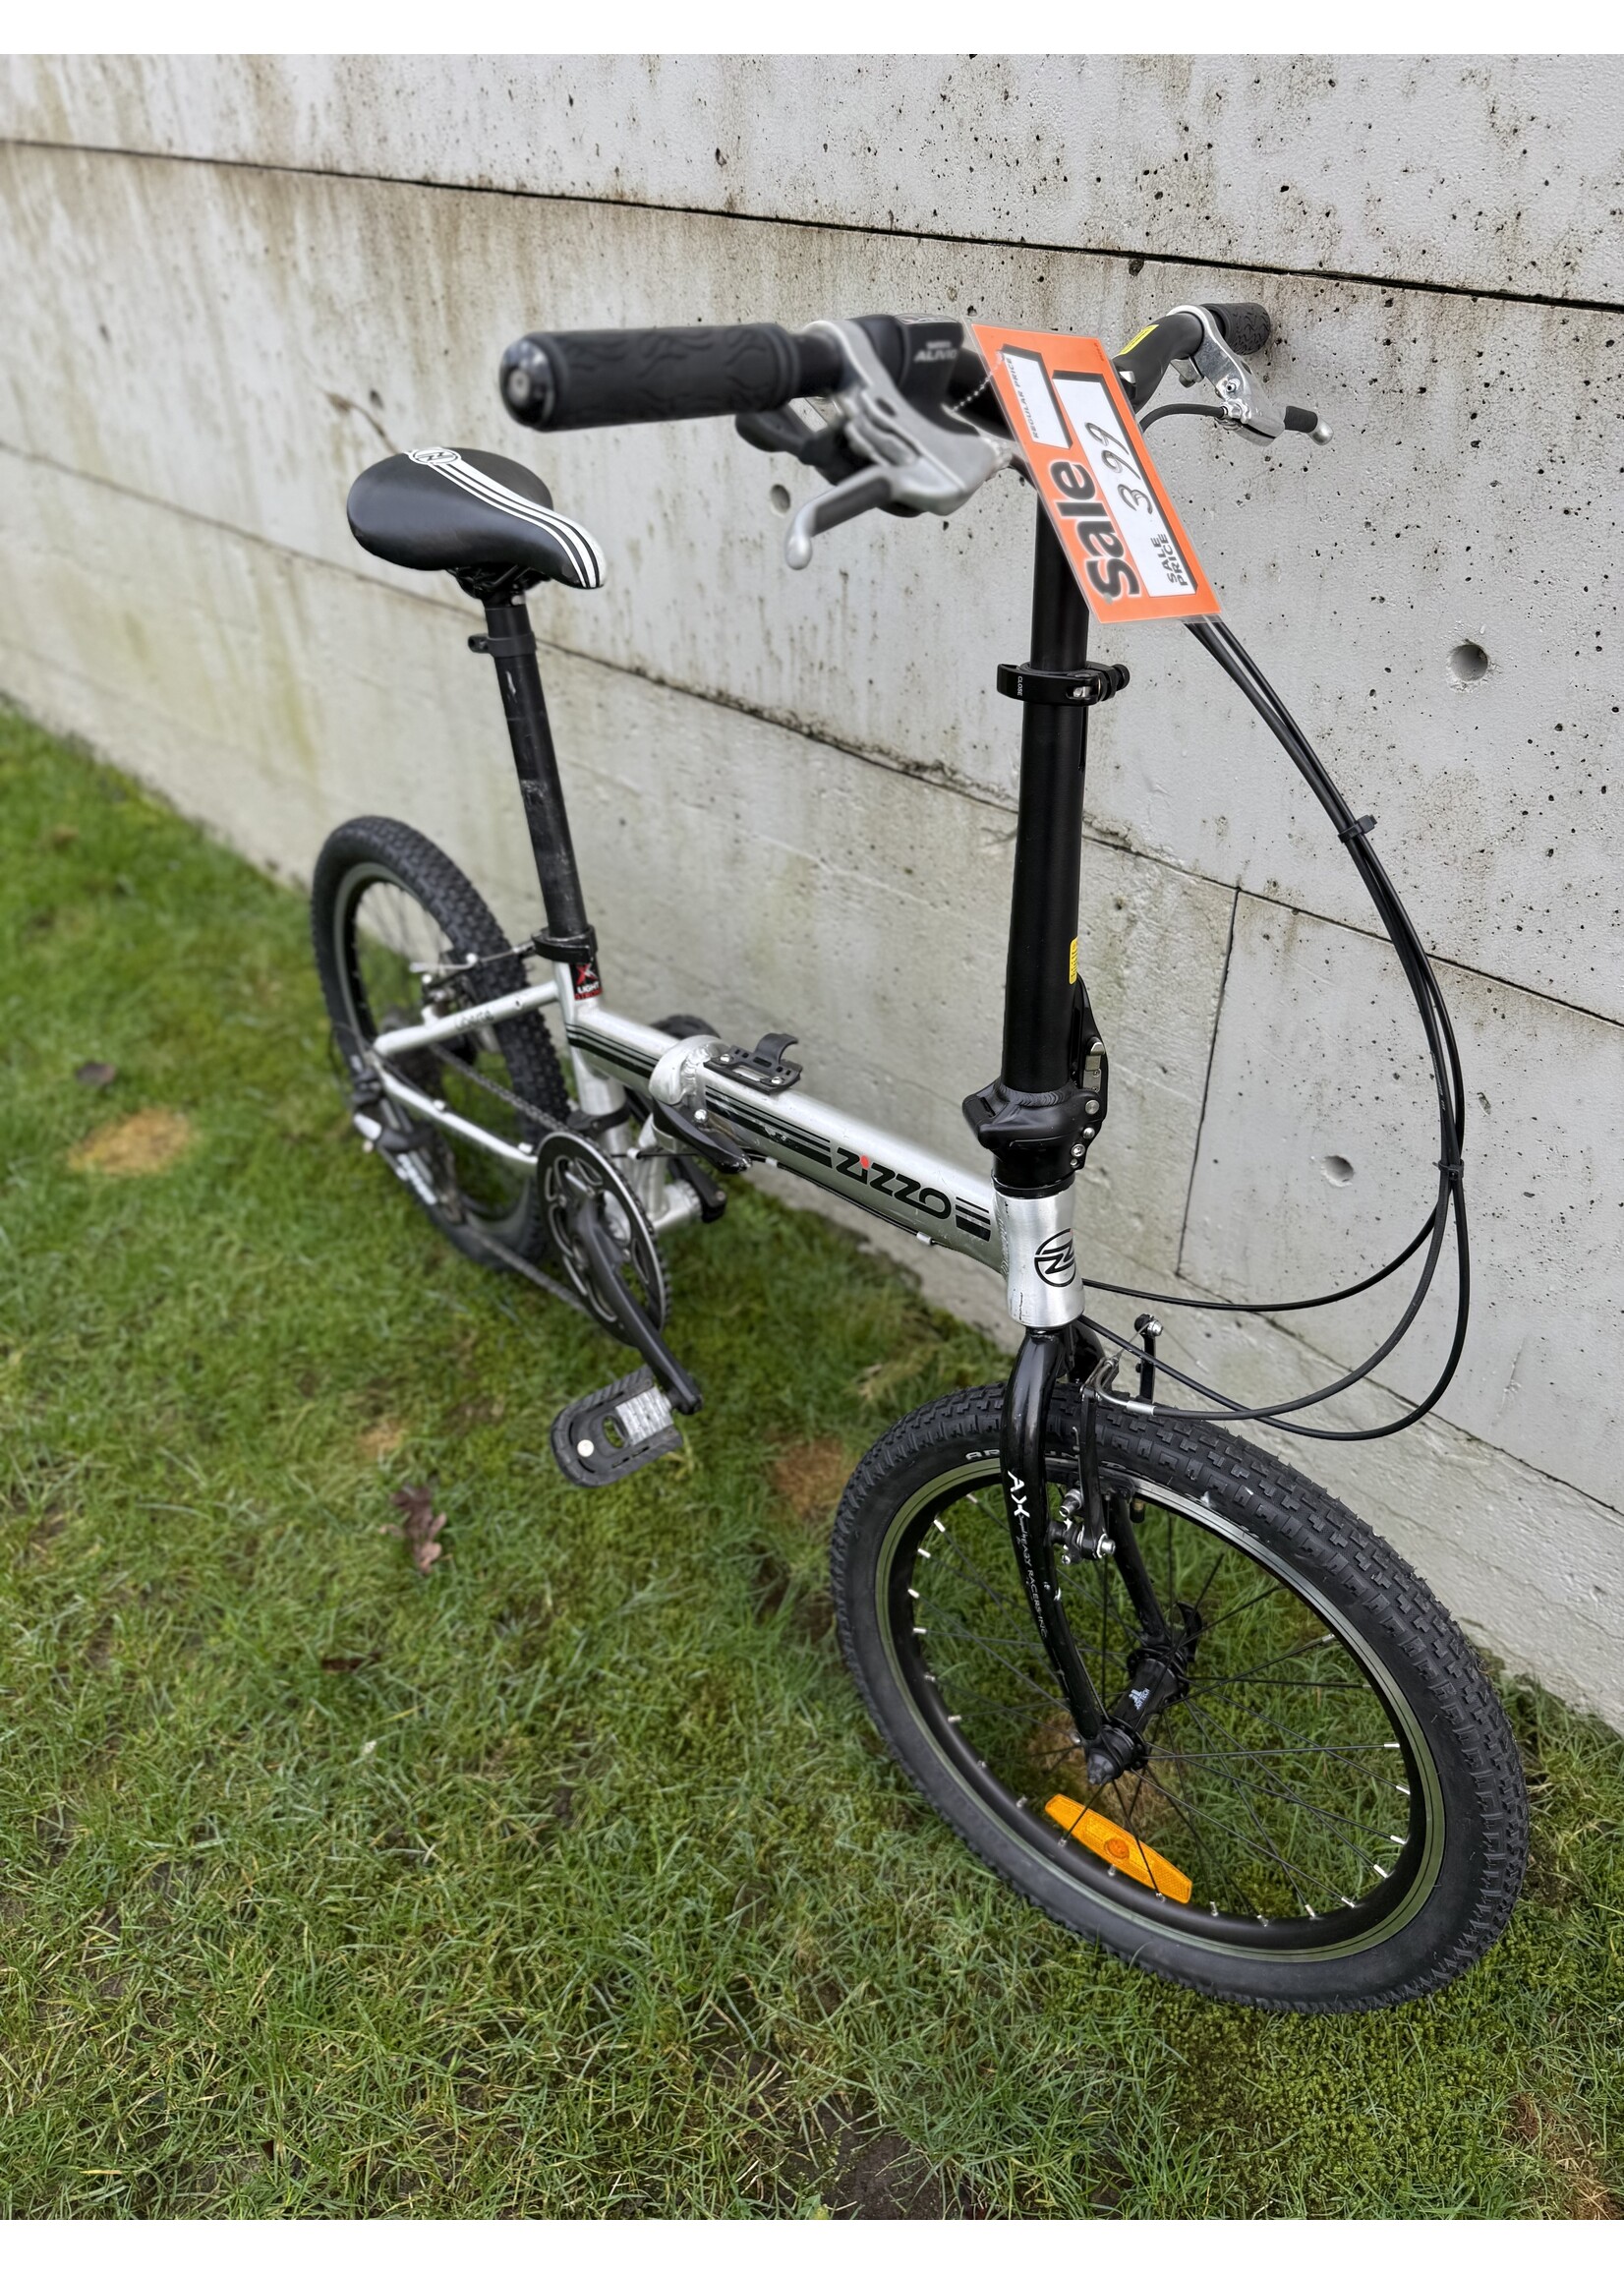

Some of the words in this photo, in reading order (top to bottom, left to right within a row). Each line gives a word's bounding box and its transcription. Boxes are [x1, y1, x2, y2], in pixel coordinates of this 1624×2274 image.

[1006, 357, 1020, 388] PRICE
[1016, 390, 1039, 439] REGULAR
[1049, 460, 1140, 599] Sale
[1149, 537, 1179, 584] SALE
[1156, 533, 1189, 586] PRICE
